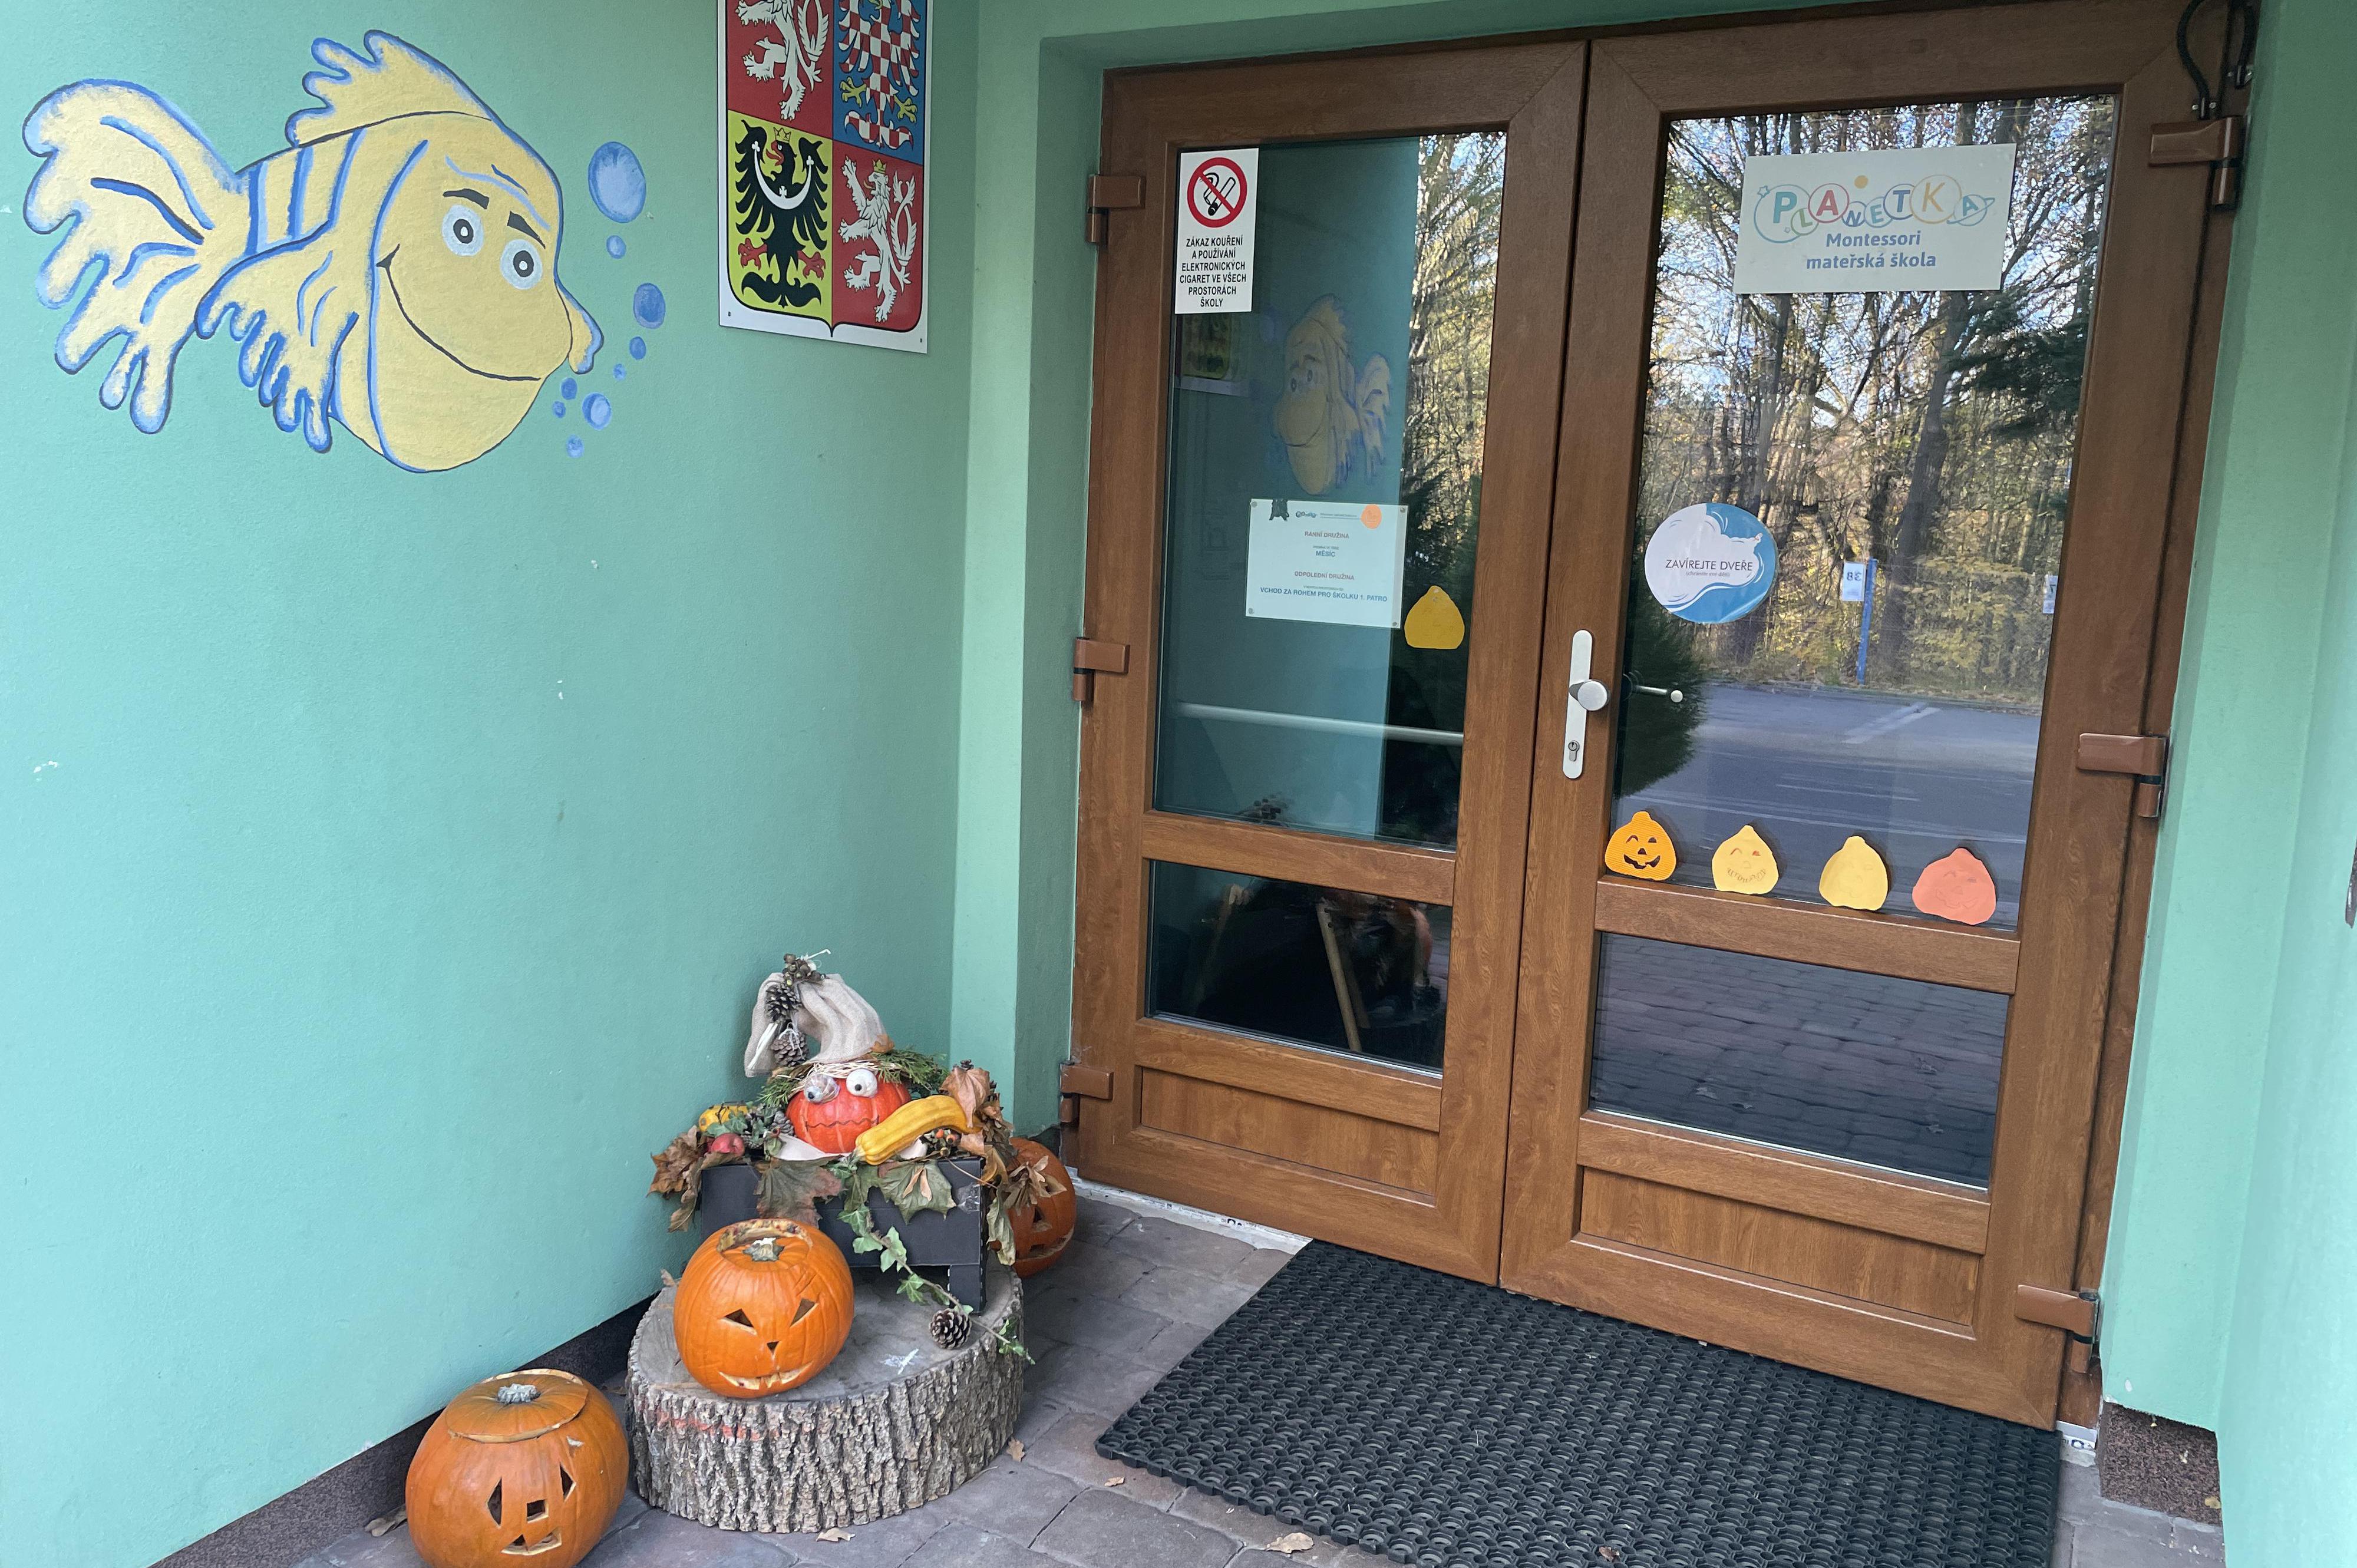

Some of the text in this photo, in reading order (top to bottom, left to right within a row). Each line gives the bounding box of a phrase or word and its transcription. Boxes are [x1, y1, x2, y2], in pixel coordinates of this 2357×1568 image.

[1772, 182, 1979, 229] PLANETKA
[1186, 235, 1243, 247] ZÁKAZ KOUŘENÍ
[1826, 230, 1921, 247] Montessori
[1192, 247, 1236, 259] A POUŽÍVÁNÍ
[1182, 260, 1245, 271] ELEKTRONICKÝCH
[1806, 251, 1936, 269] mateřská škola
[1180, 272, 1246, 283] CIGARET VE VŠECH
[1189, 284, 1236, 295] PROSTORÁCH
[1200, 297, 1223, 307] ŠKOLY
[1666, 557, 1753, 571] ZAVÍREJTE DVEŘE
